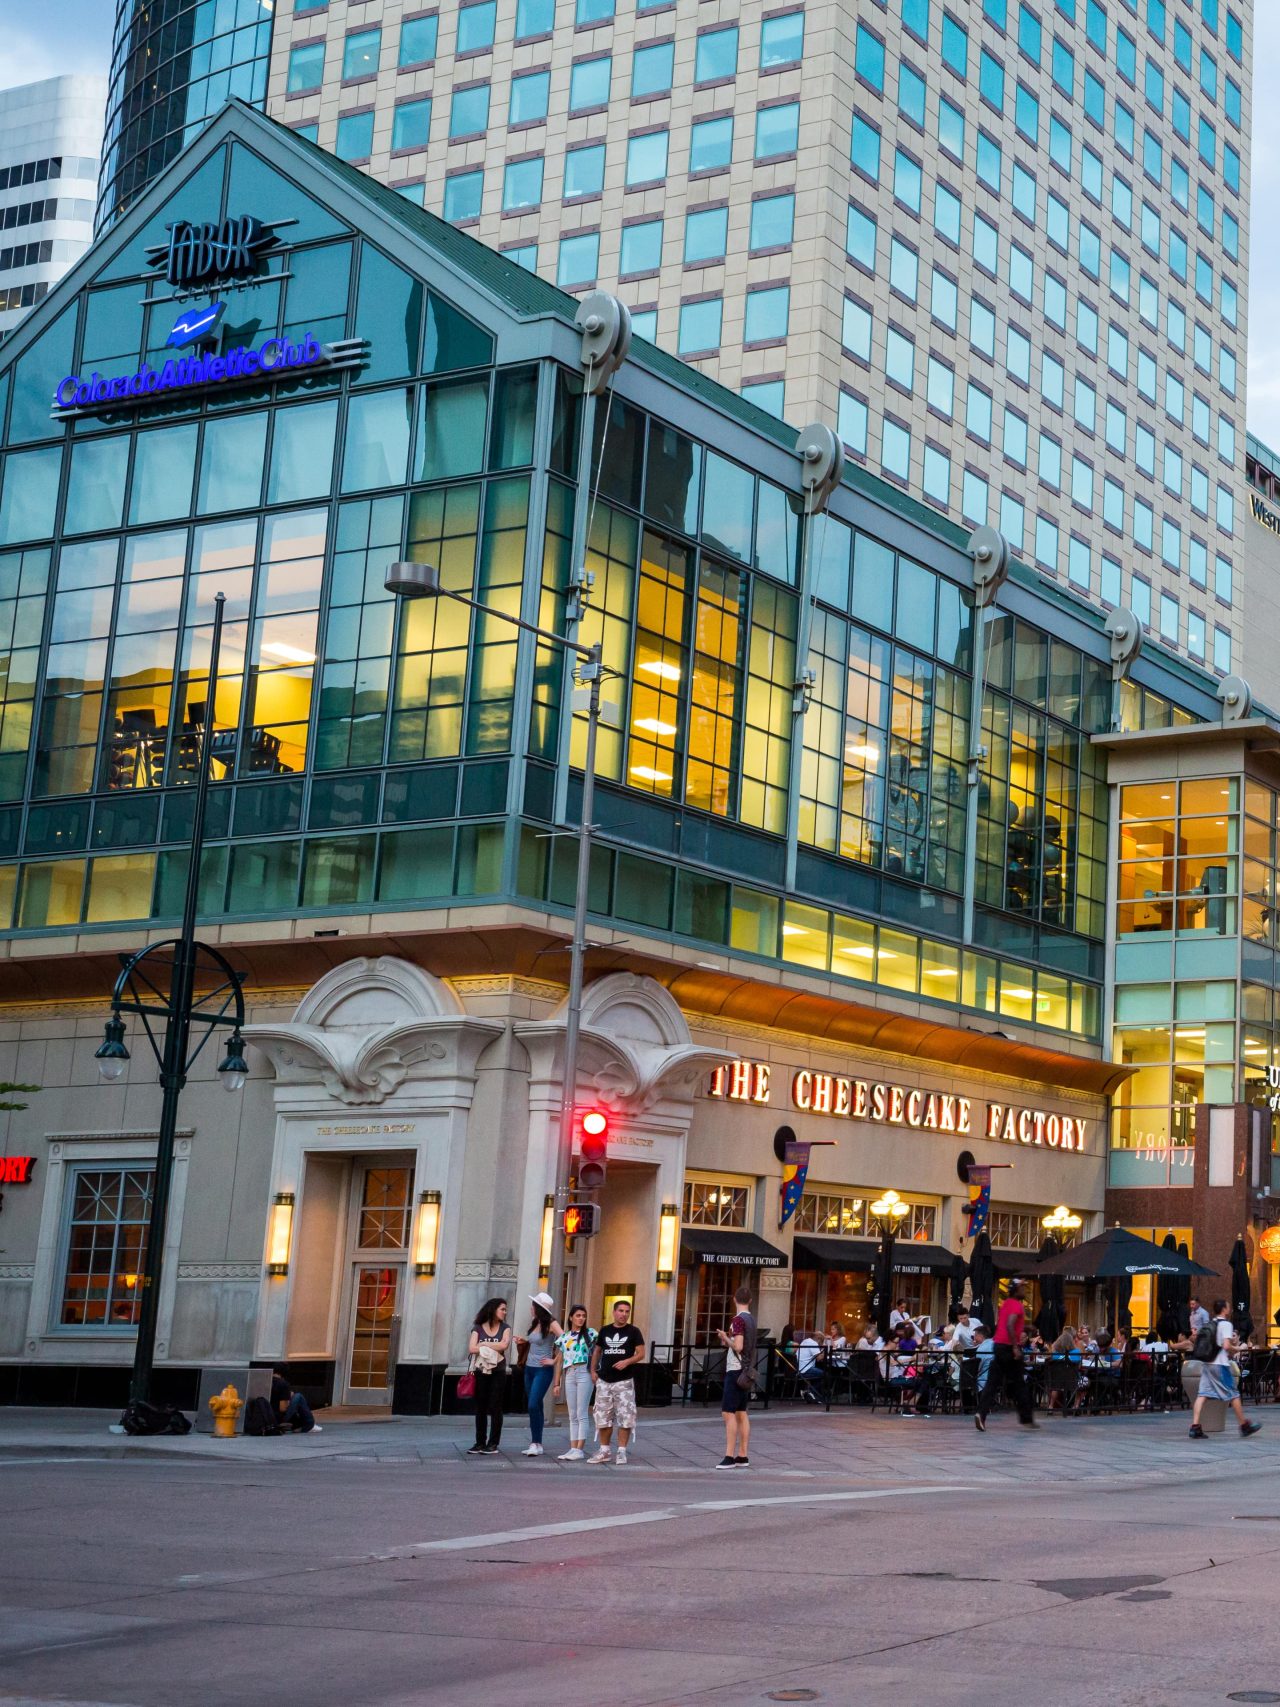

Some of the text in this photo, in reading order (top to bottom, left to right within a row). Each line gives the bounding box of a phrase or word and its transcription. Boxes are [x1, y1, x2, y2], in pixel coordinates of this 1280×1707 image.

[166, 214, 259, 284] TABOR
[712, 1061, 1087, 1151] THE CHEESECAKE FACTORY
[1270, 1093, 1280, 1112] of
[702, 1253, 780, 1266] THE CHEESECAKE FACTORY
[902, 1265, 920, 1273] BAKERY
